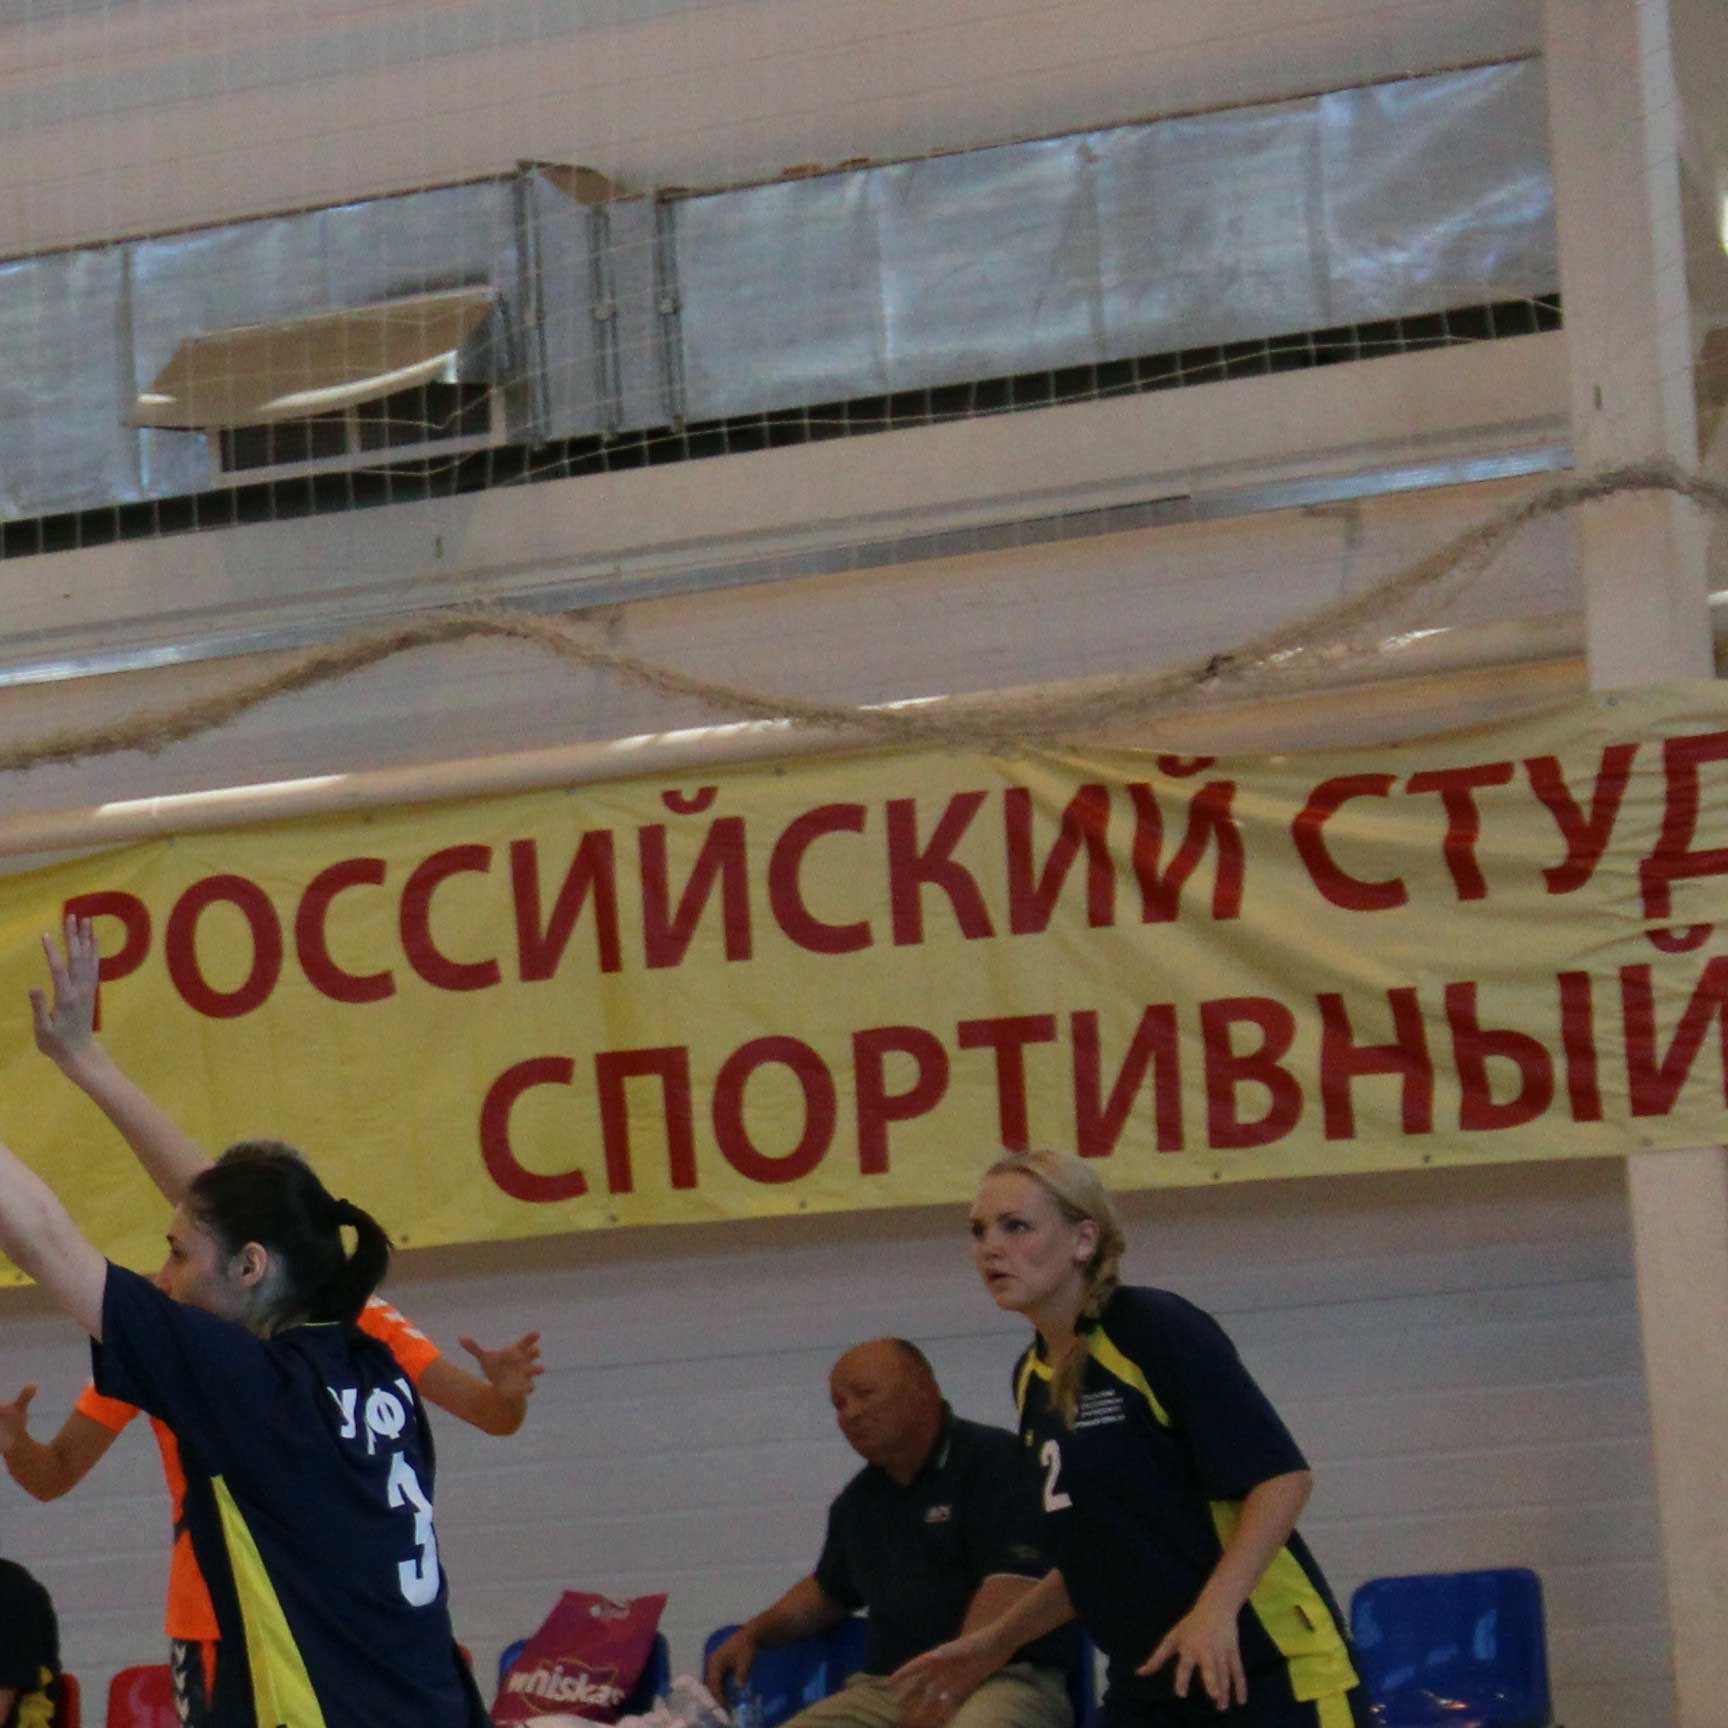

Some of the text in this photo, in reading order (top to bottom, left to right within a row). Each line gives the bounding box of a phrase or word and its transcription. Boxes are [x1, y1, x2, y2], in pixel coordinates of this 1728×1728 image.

[63, 757, 1244, 1033] РОССИЙСКИЙ
[479, 923, 1728, 1202] СПОРТИВНЫЙ
[387, 1451, 440, 1608] 3
[1040, 1439, 1073, 1513] 2
